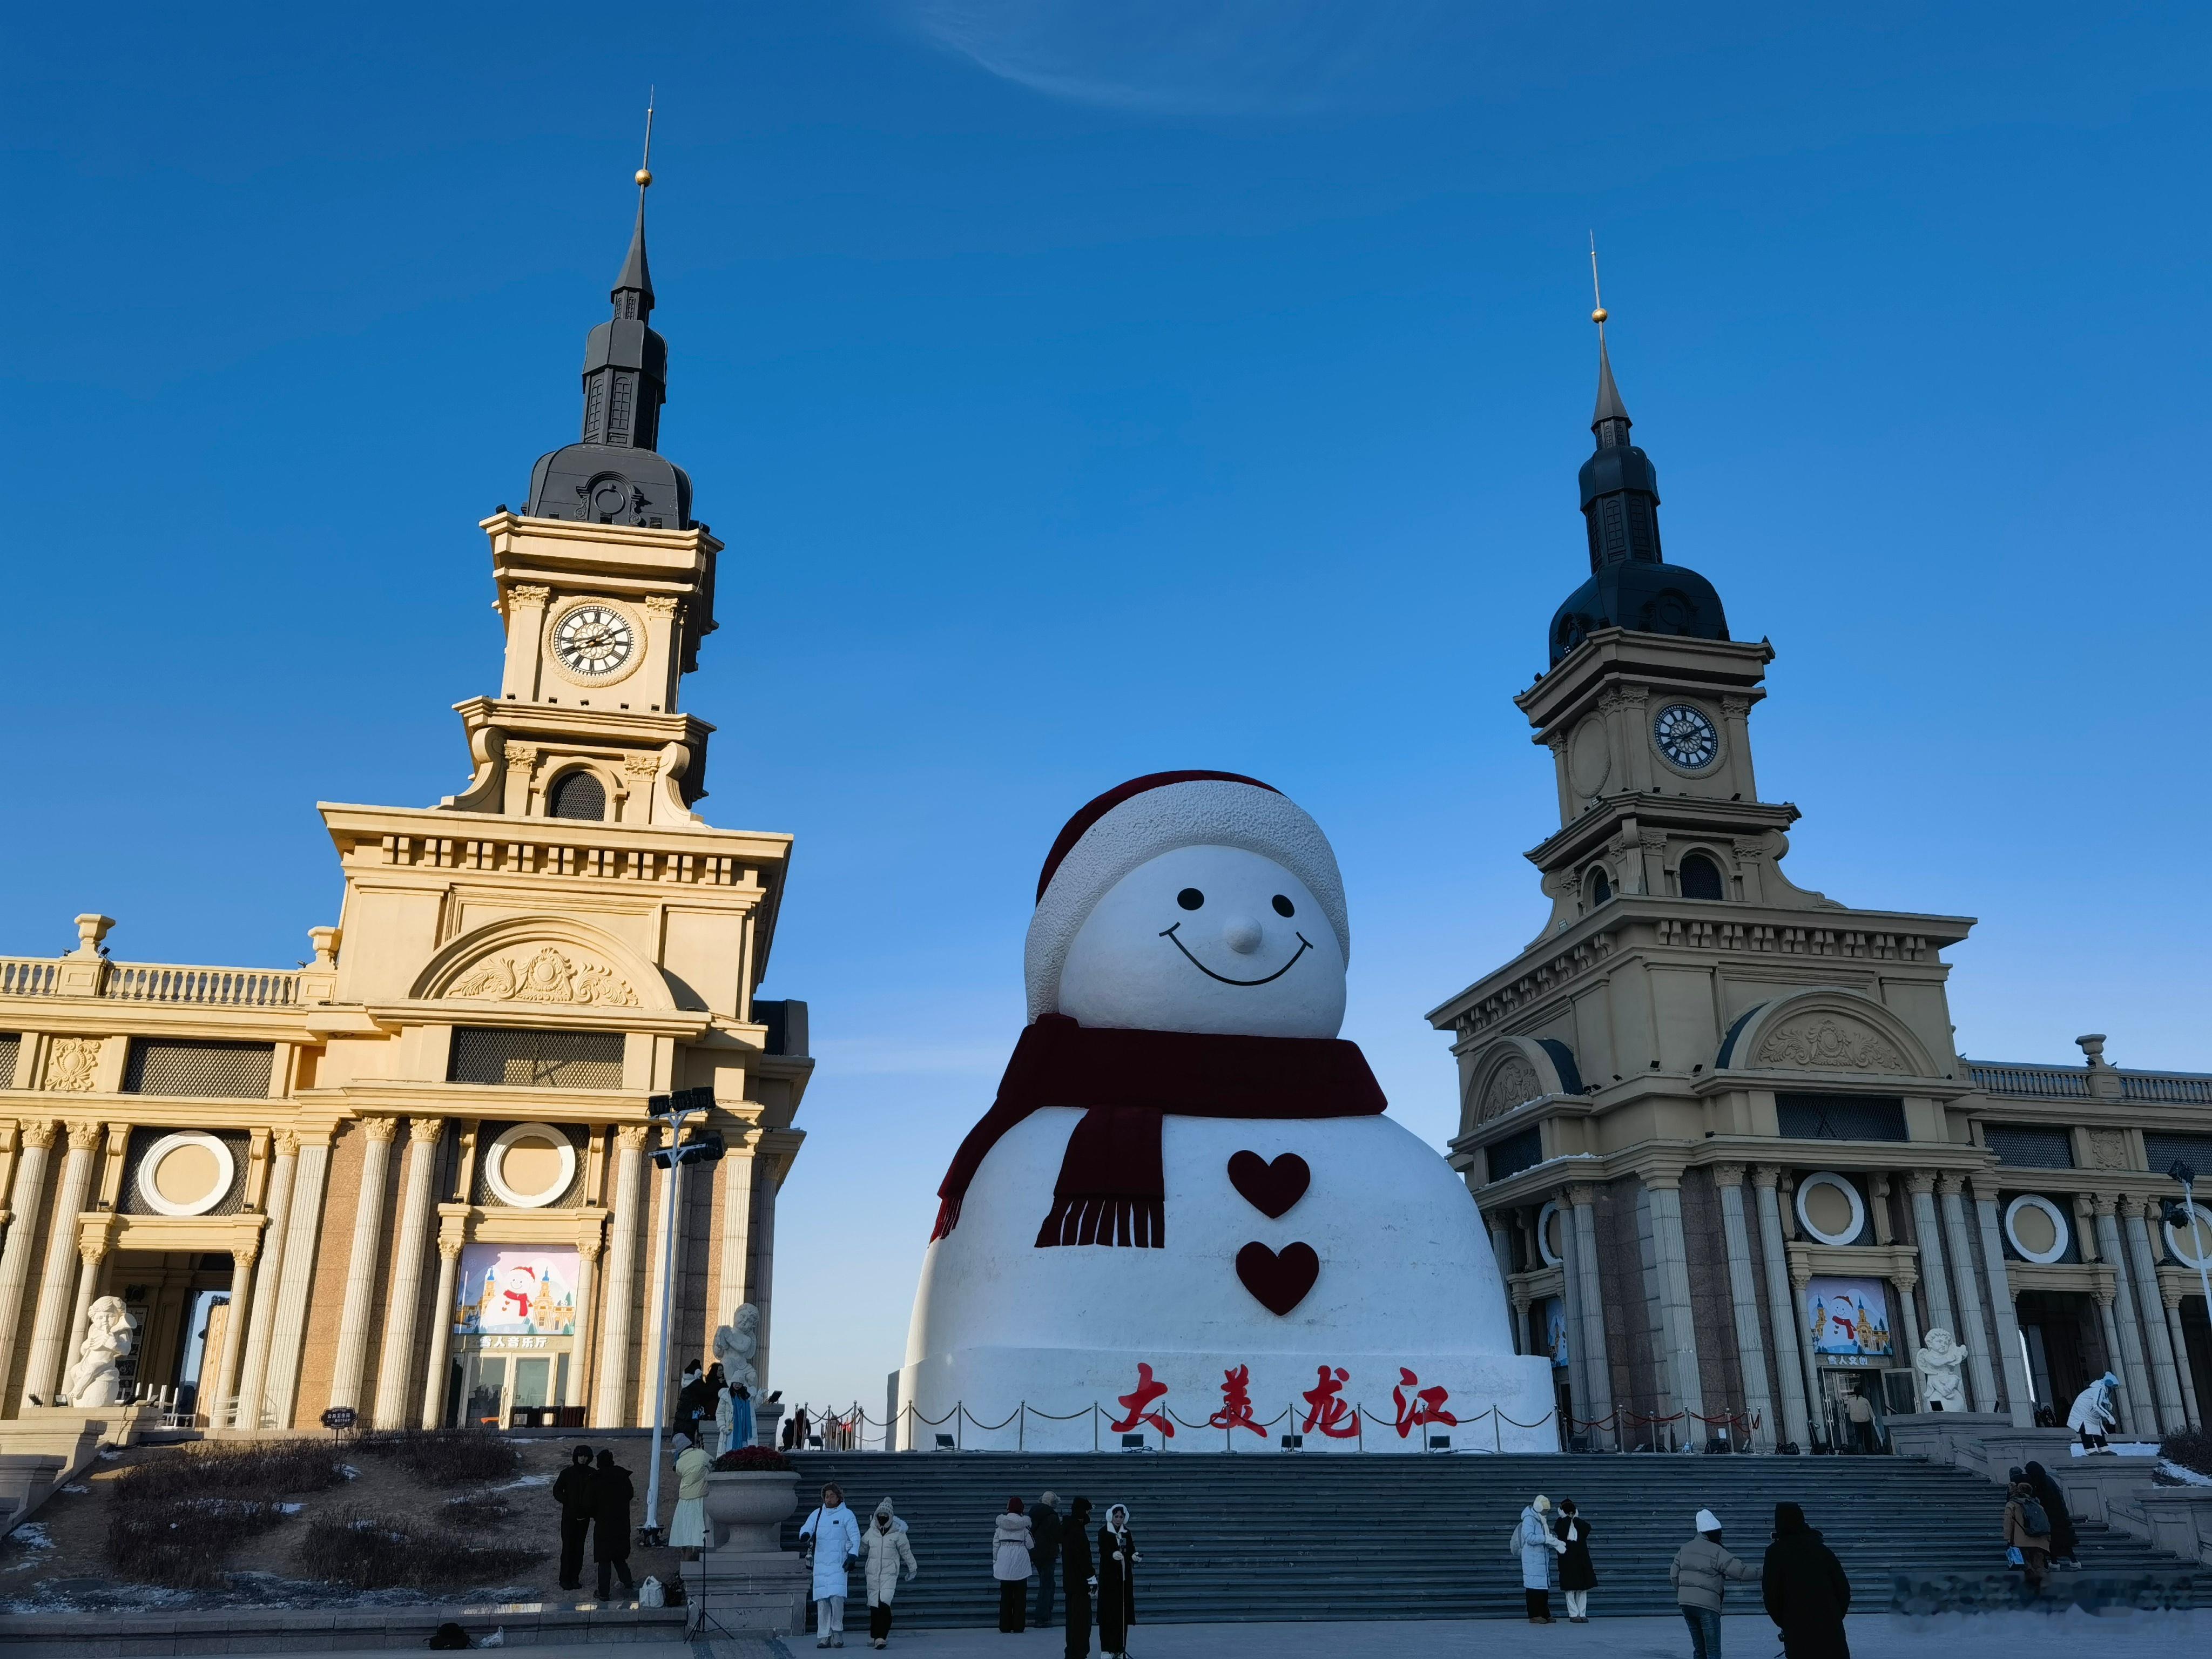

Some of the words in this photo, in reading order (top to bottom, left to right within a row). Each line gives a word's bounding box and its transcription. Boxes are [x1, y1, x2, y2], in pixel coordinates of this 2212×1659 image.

[480, 1336, 548, 1348] 雪人音乐厅
[1111, 1363, 1457, 1438] 大美龙江
